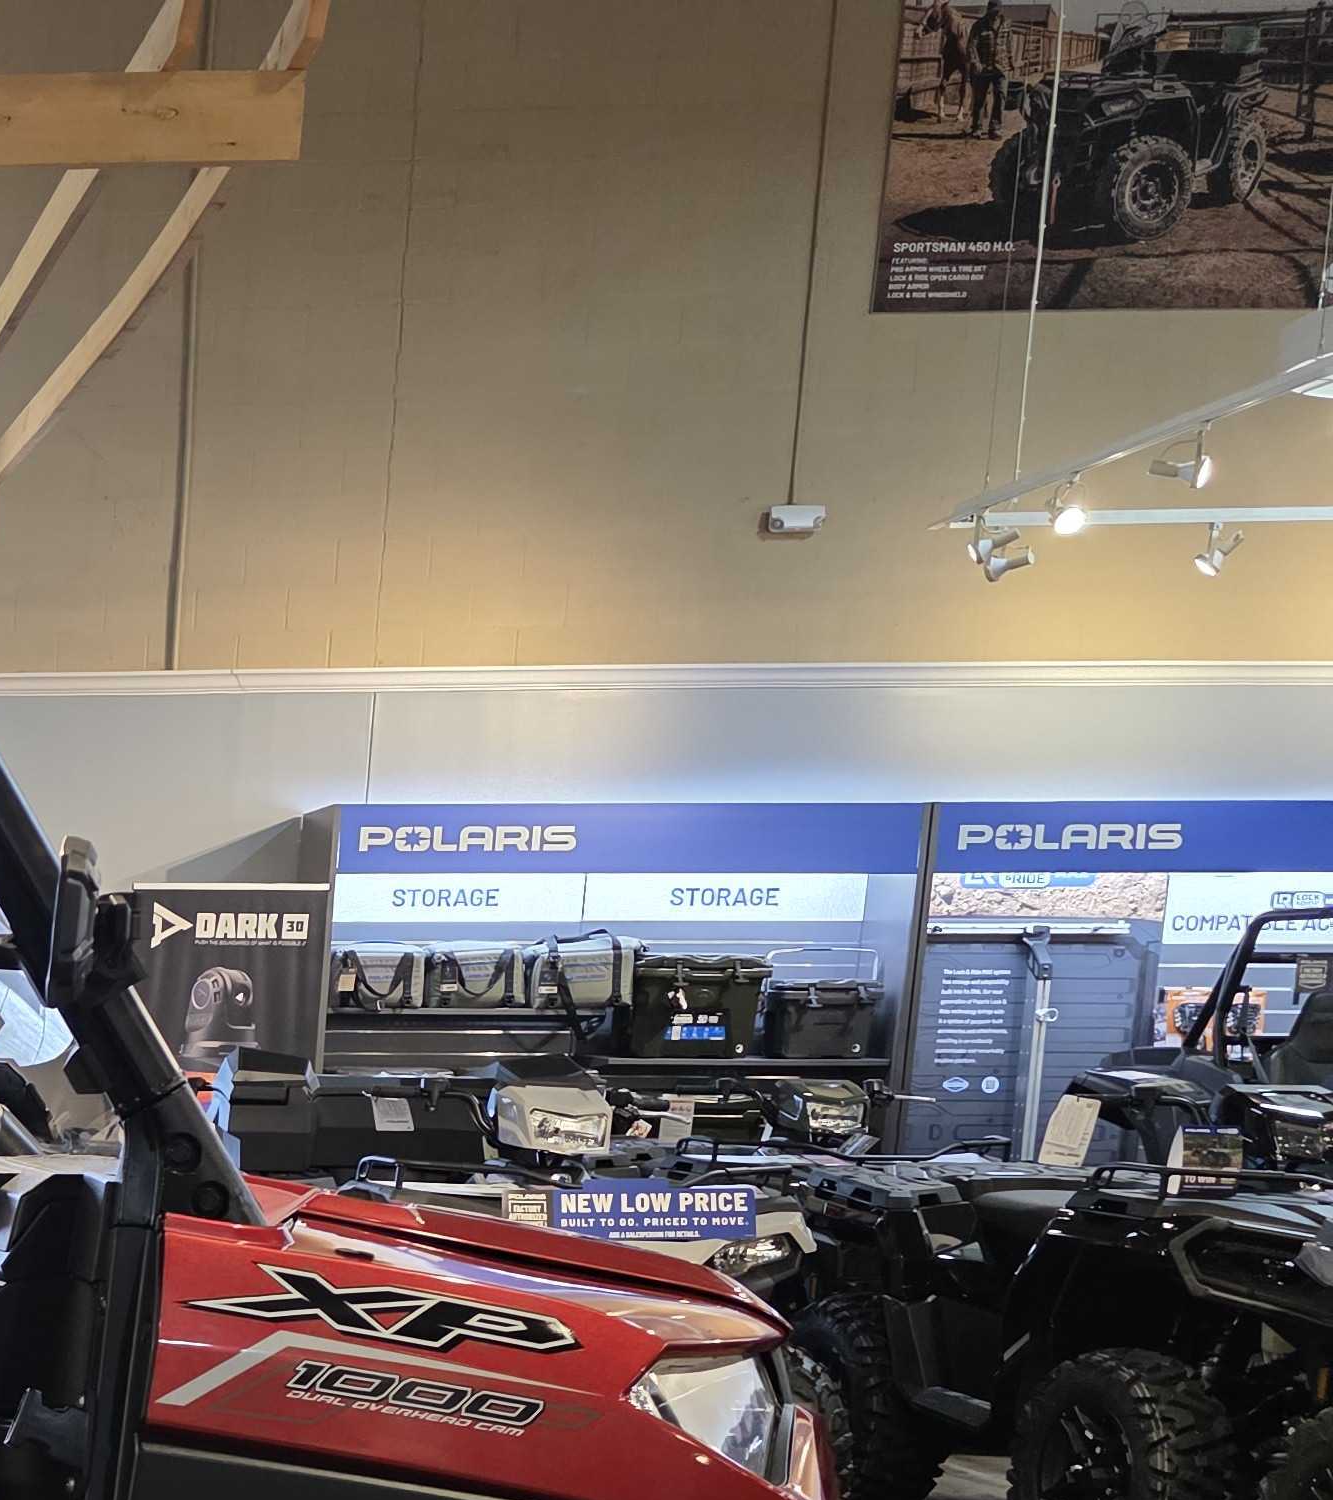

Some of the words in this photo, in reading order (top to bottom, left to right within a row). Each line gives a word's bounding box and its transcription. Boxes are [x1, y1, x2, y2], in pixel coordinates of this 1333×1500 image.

[893, 241, 966, 253] SPORTSMAN
[968, 241, 991, 252] 450
[993, 240, 1016, 252] H.O.
[358, 825, 577, 852] POLARIS
[957, 822, 1183, 851] POLARIS
[391, 888, 500, 909] STORAGE
[669, 887, 781, 908] STORAGE
[194, 912, 279, 939] DARK
[286, 920, 304, 932] 30
[561, 1193, 614, 1213] NEW
[620, 1193, 672, 1213] LOW
[679, 1192, 749, 1212] PRICE
[561, 1218, 596, 1227] BUILT
[599, 1218, 615, 1227] TO
[644, 1217, 688, 1226] PRICED
[693, 1217, 708, 1226] TO
[182, 1261, 581, 1353] XP
[286, 1360, 544, 1427] 1000
[286, 1390, 346, 1407] DUAL
[351, 1401, 472, 1428] OVERHEAD
[473, 1422, 526, 1438] CAM
